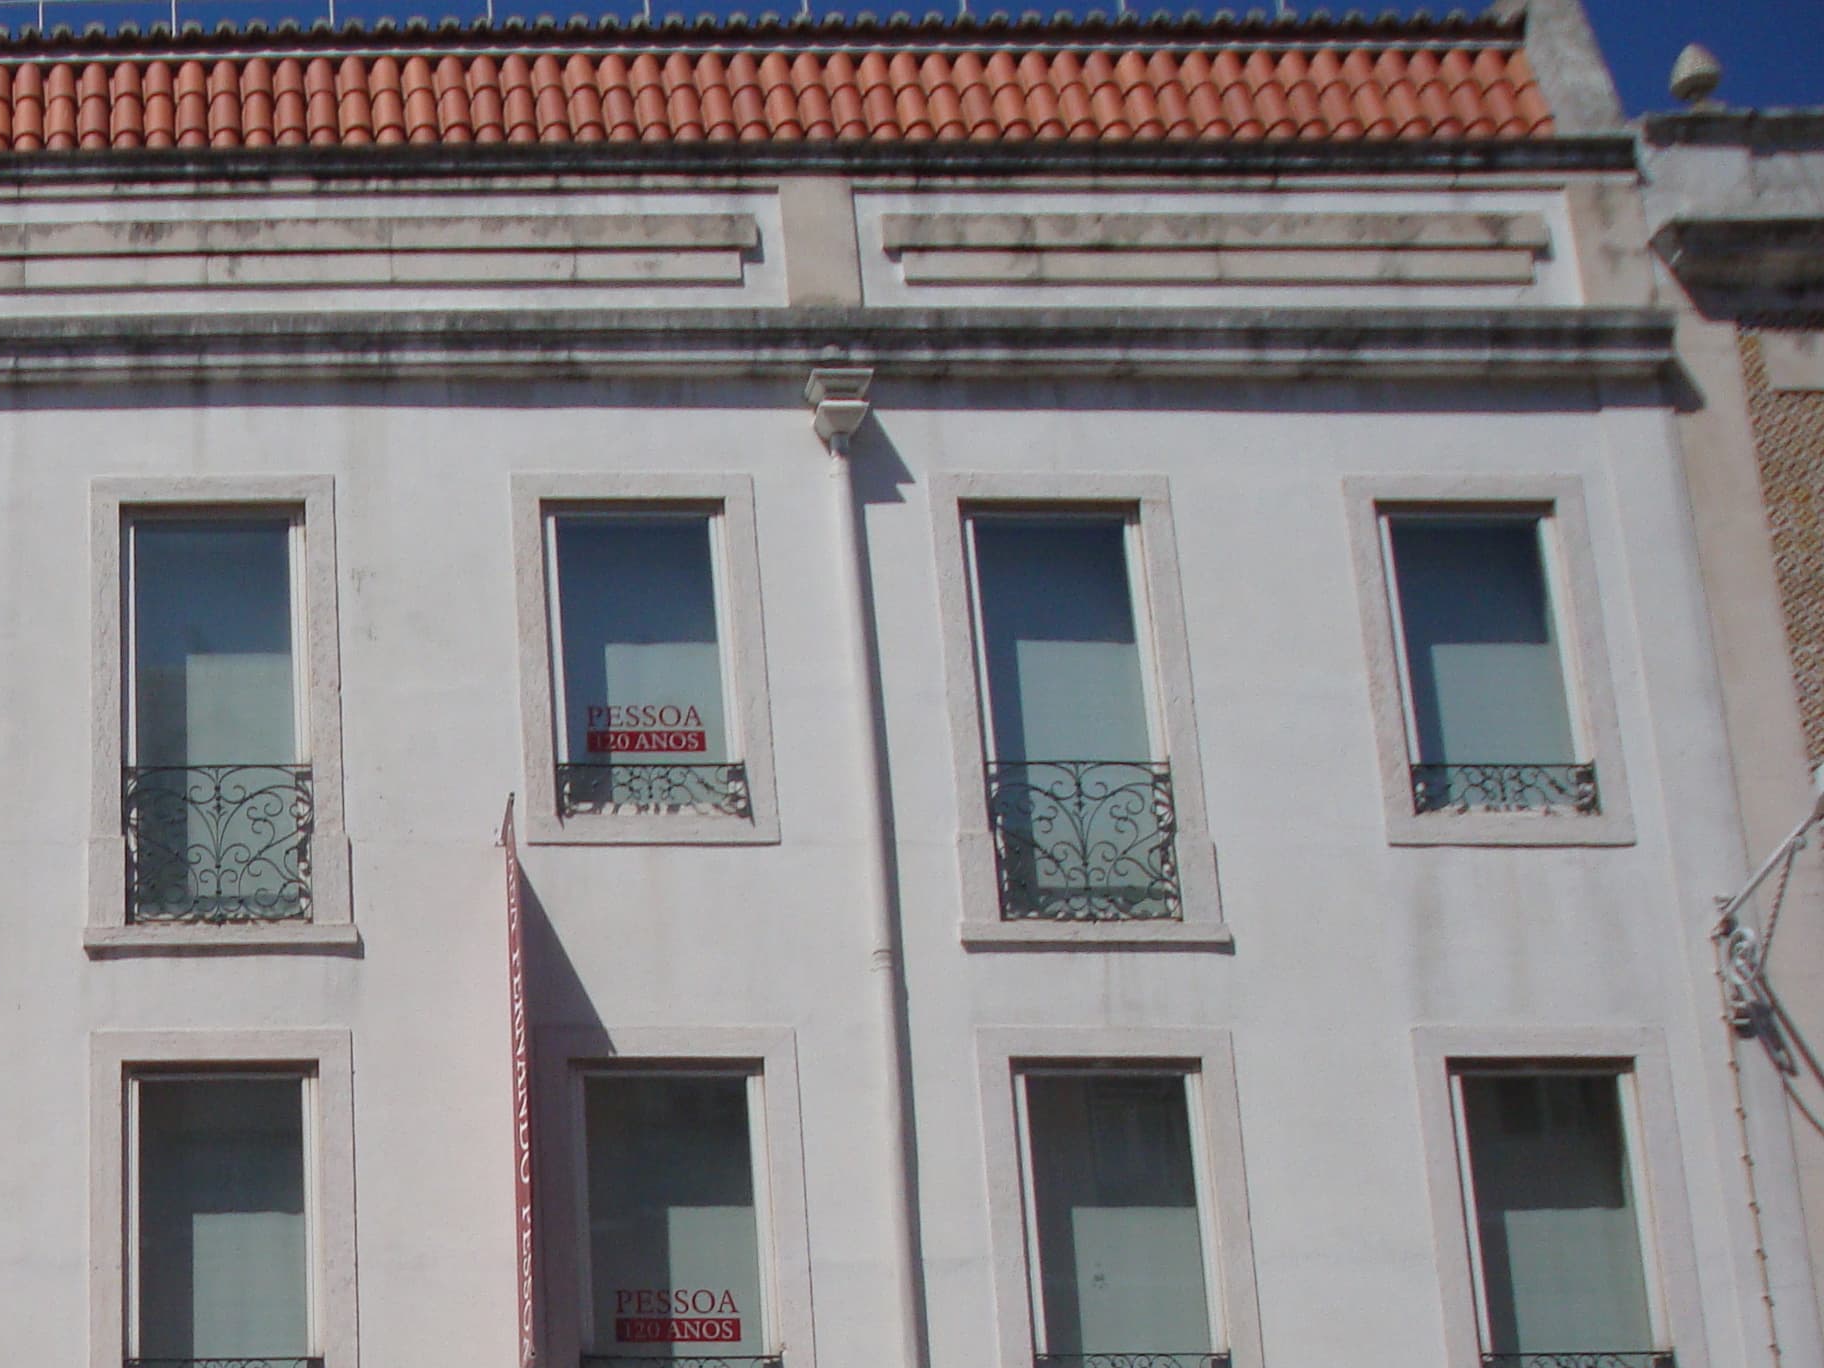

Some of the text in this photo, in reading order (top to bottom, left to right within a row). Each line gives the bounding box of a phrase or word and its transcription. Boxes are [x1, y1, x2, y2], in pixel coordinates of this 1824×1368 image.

[587, 705, 703, 727] PESSOA
[595, 731, 699, 749] 120 ANOS
[615, 1289, 739, 1314] PESSOA
[623, 1320, 734, 1340] 120 ANOS
